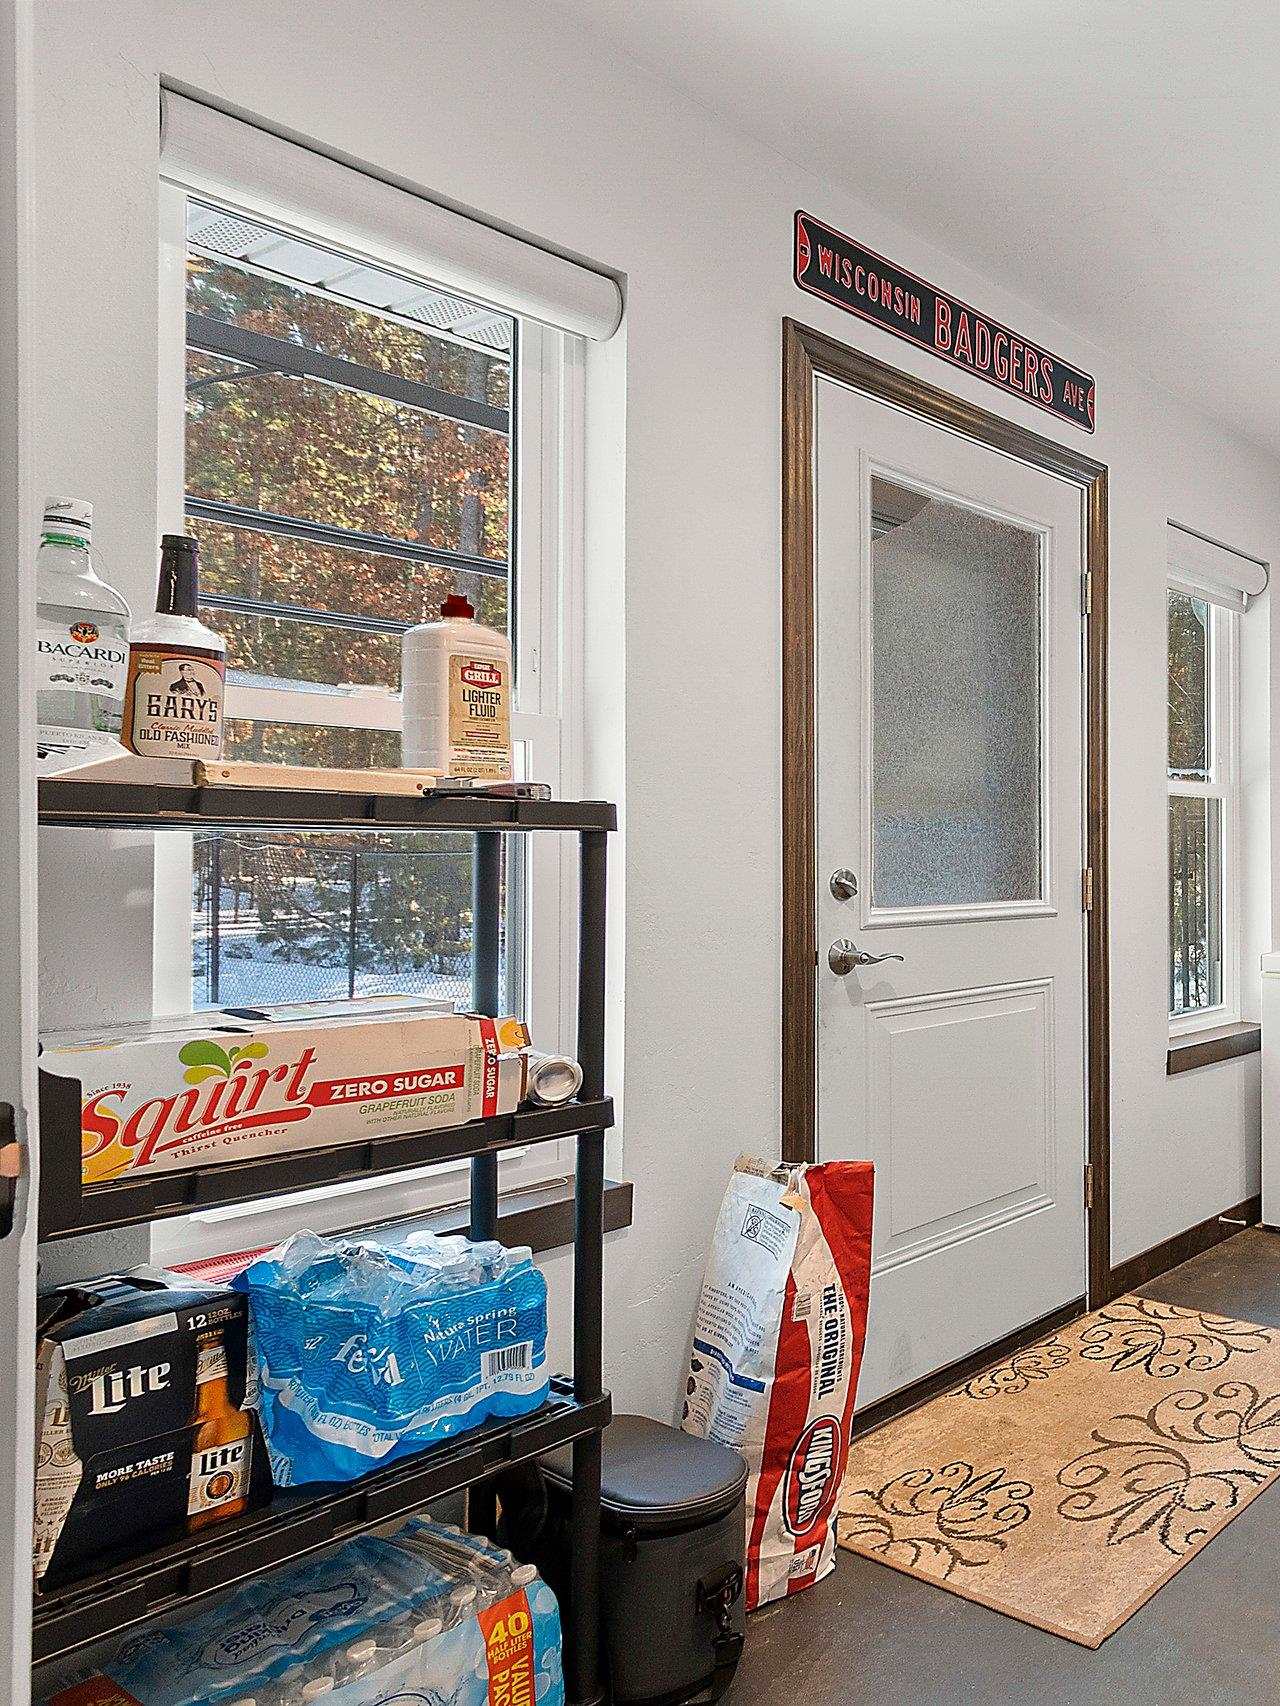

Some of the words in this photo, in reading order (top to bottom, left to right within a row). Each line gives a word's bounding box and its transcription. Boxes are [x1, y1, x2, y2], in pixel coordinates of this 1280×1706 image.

[818, 244, 921, 326] WISCONSIN
[934, 296, 1054, 405] BADGERS
[1062, 380, 1086, 412] AVE
[37, 640, 126, 664] BACARDI
[466, 670, 498, 682] GRILL
[147, 694, 218, 723] GARY'S
[462, 689, 501, 706] LIGHTER
[469, 704, 496, 718] FLUID
[139, 728, 161, 741] OLD
[165, 731, 219, 747] FASHIONED
[176, 742, 191, 750] MIX
[86, 1084, 109, 1097] Since
[330, 1080, 388, 1100] ZERO
[393, 1071, 456, 1092] SUGAR
[486, 1067, 496, 1099] SUGAR
[81, 1046, 317, 1169] Squirt
[359, 1097, 427, 1115] GRAPEFRUIT
[428, 1093, 456, 1105] SODA
[170, 1141, 217, 1159] Thirst
[222, 1127, 288, 1145] Quencher
[182, 1127, 222, 1144] caffeine
[223, 1122, 243, 1133] free
[823, 1283, 838, 1315] THE
[187, 1314, 208, 1331] 12
[818, 1317, 839, 1400] ORIGINAL
[837, 1342, 845, 1382] INGREDIENTS
[70, 1362, 117, 1394] Miller
[87, 1362, 170, 1416] Lite
[95, 1464, 134, 1483] MORE
[136, 1452, 175, 1470] TASTE
[95, 1478, 118, 1489] ONLY
[131, 1460, 173, 1478] CALORIES
[199, 1445, 243, 1476] Lite
[798, 1426, 833, 1524] KINGSFORD
[488, 1611, 529, 1647] 40
[487, 1643, 508, 1659] HALF
[511, 1630, 532, 1646] LITER
[493, 1641, 528, 1665] BOTTLES
[492, 1669, 511, 1706] PAC
